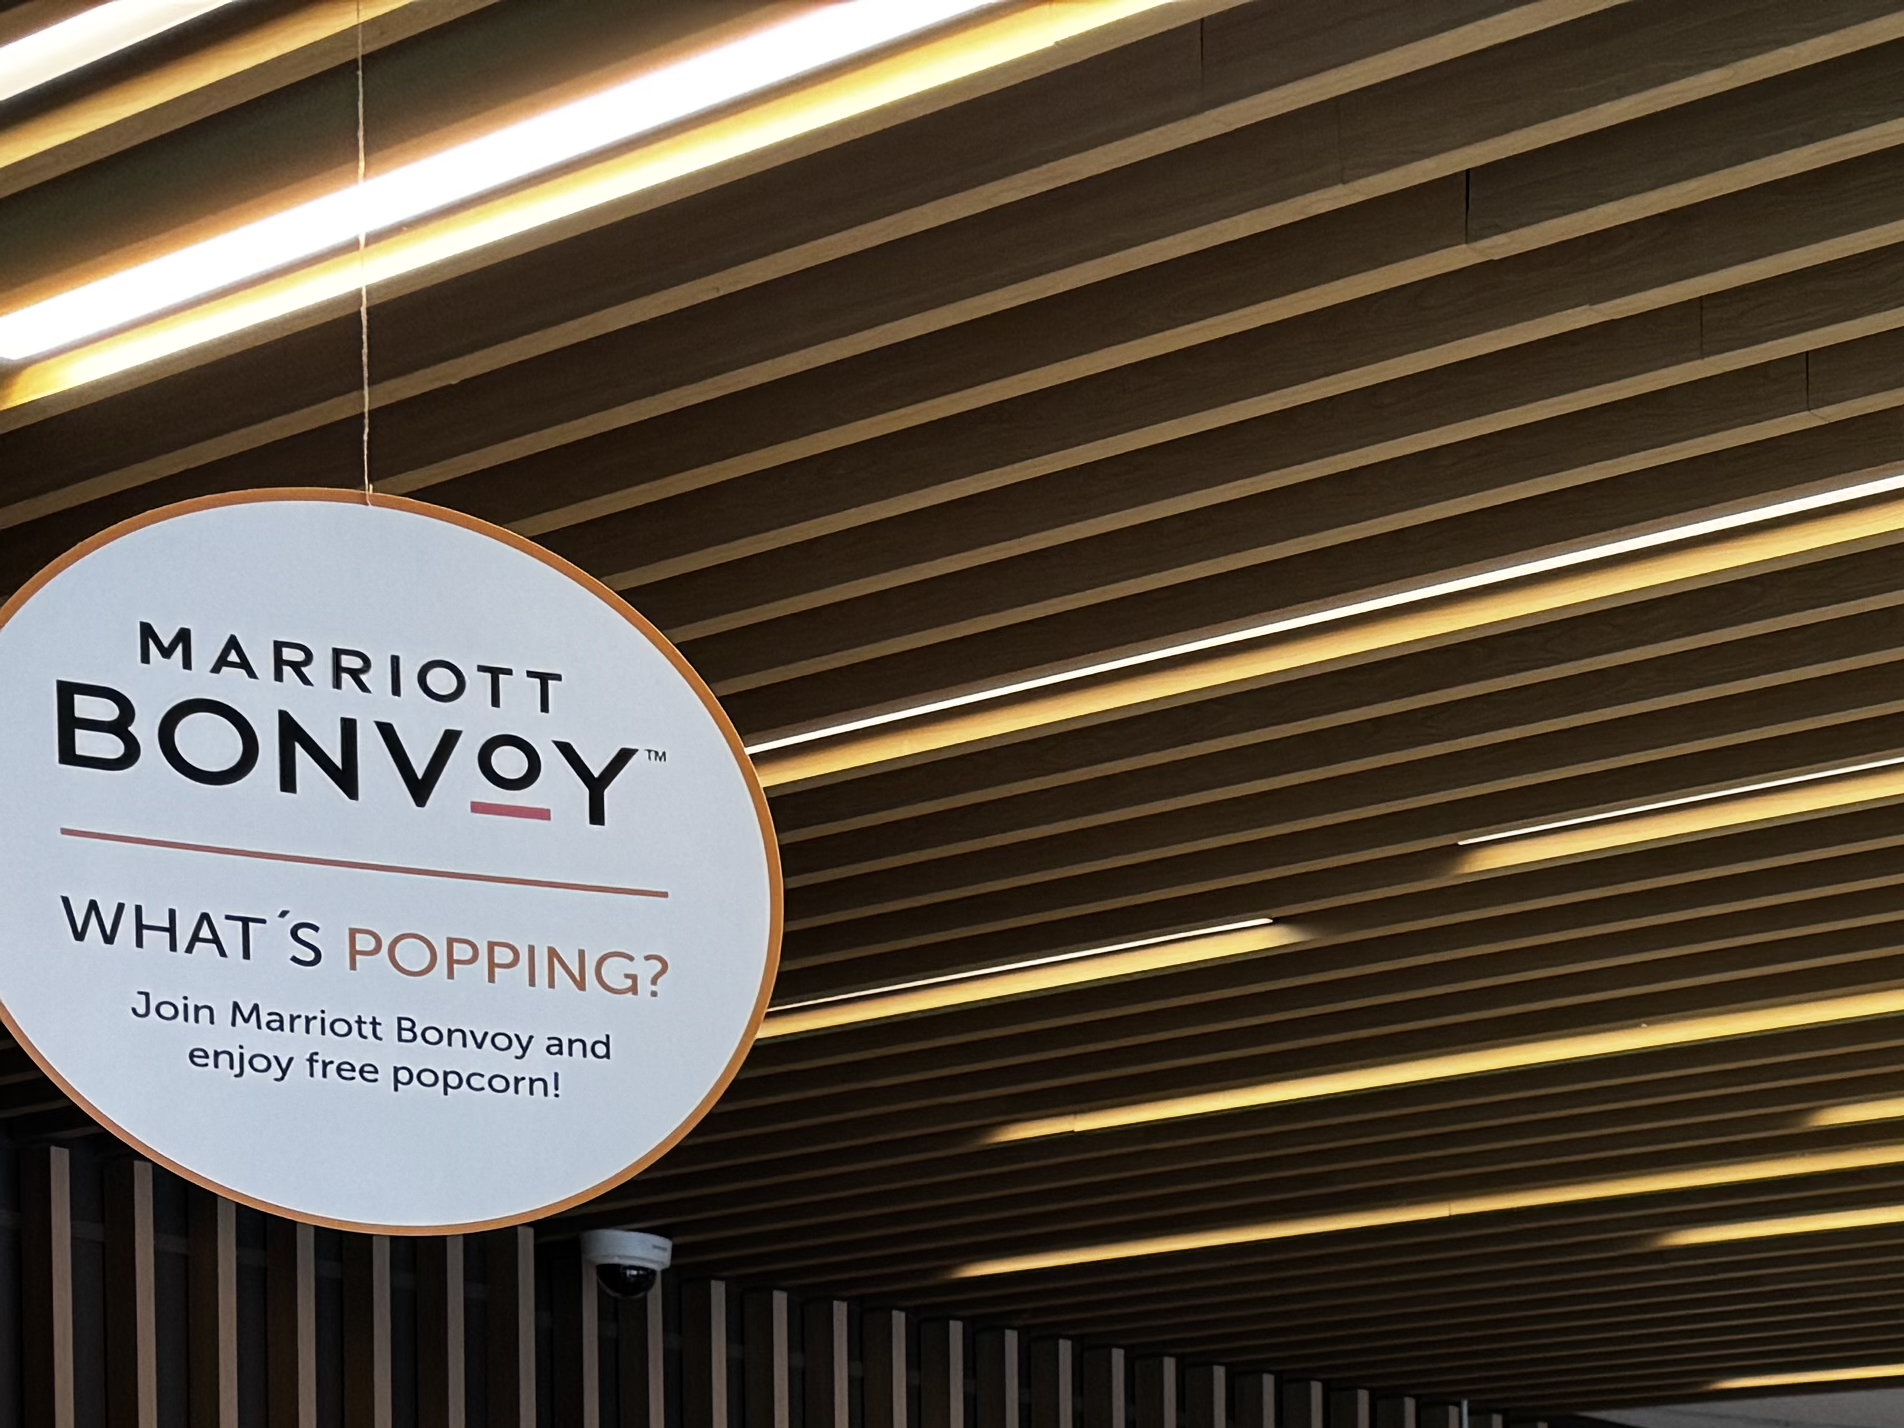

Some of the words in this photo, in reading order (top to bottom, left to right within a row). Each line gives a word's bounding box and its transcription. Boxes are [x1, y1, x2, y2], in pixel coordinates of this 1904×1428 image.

[138, 620, 563, 714] MARRIOTT
[347, 926, 669, 998] POPPING?
[130, 991, 216, 1025] Join
[229, 1001, 384, 1043] Marriott
[396, 1015, 535, 1061] Bonvoy
[544, 1031, 612, 1061] and
[188, 1043, 295, 1083] enjoy
[306, 1050, 380, 1084] free
[391, 1062, 562, 1099] popcorn!
